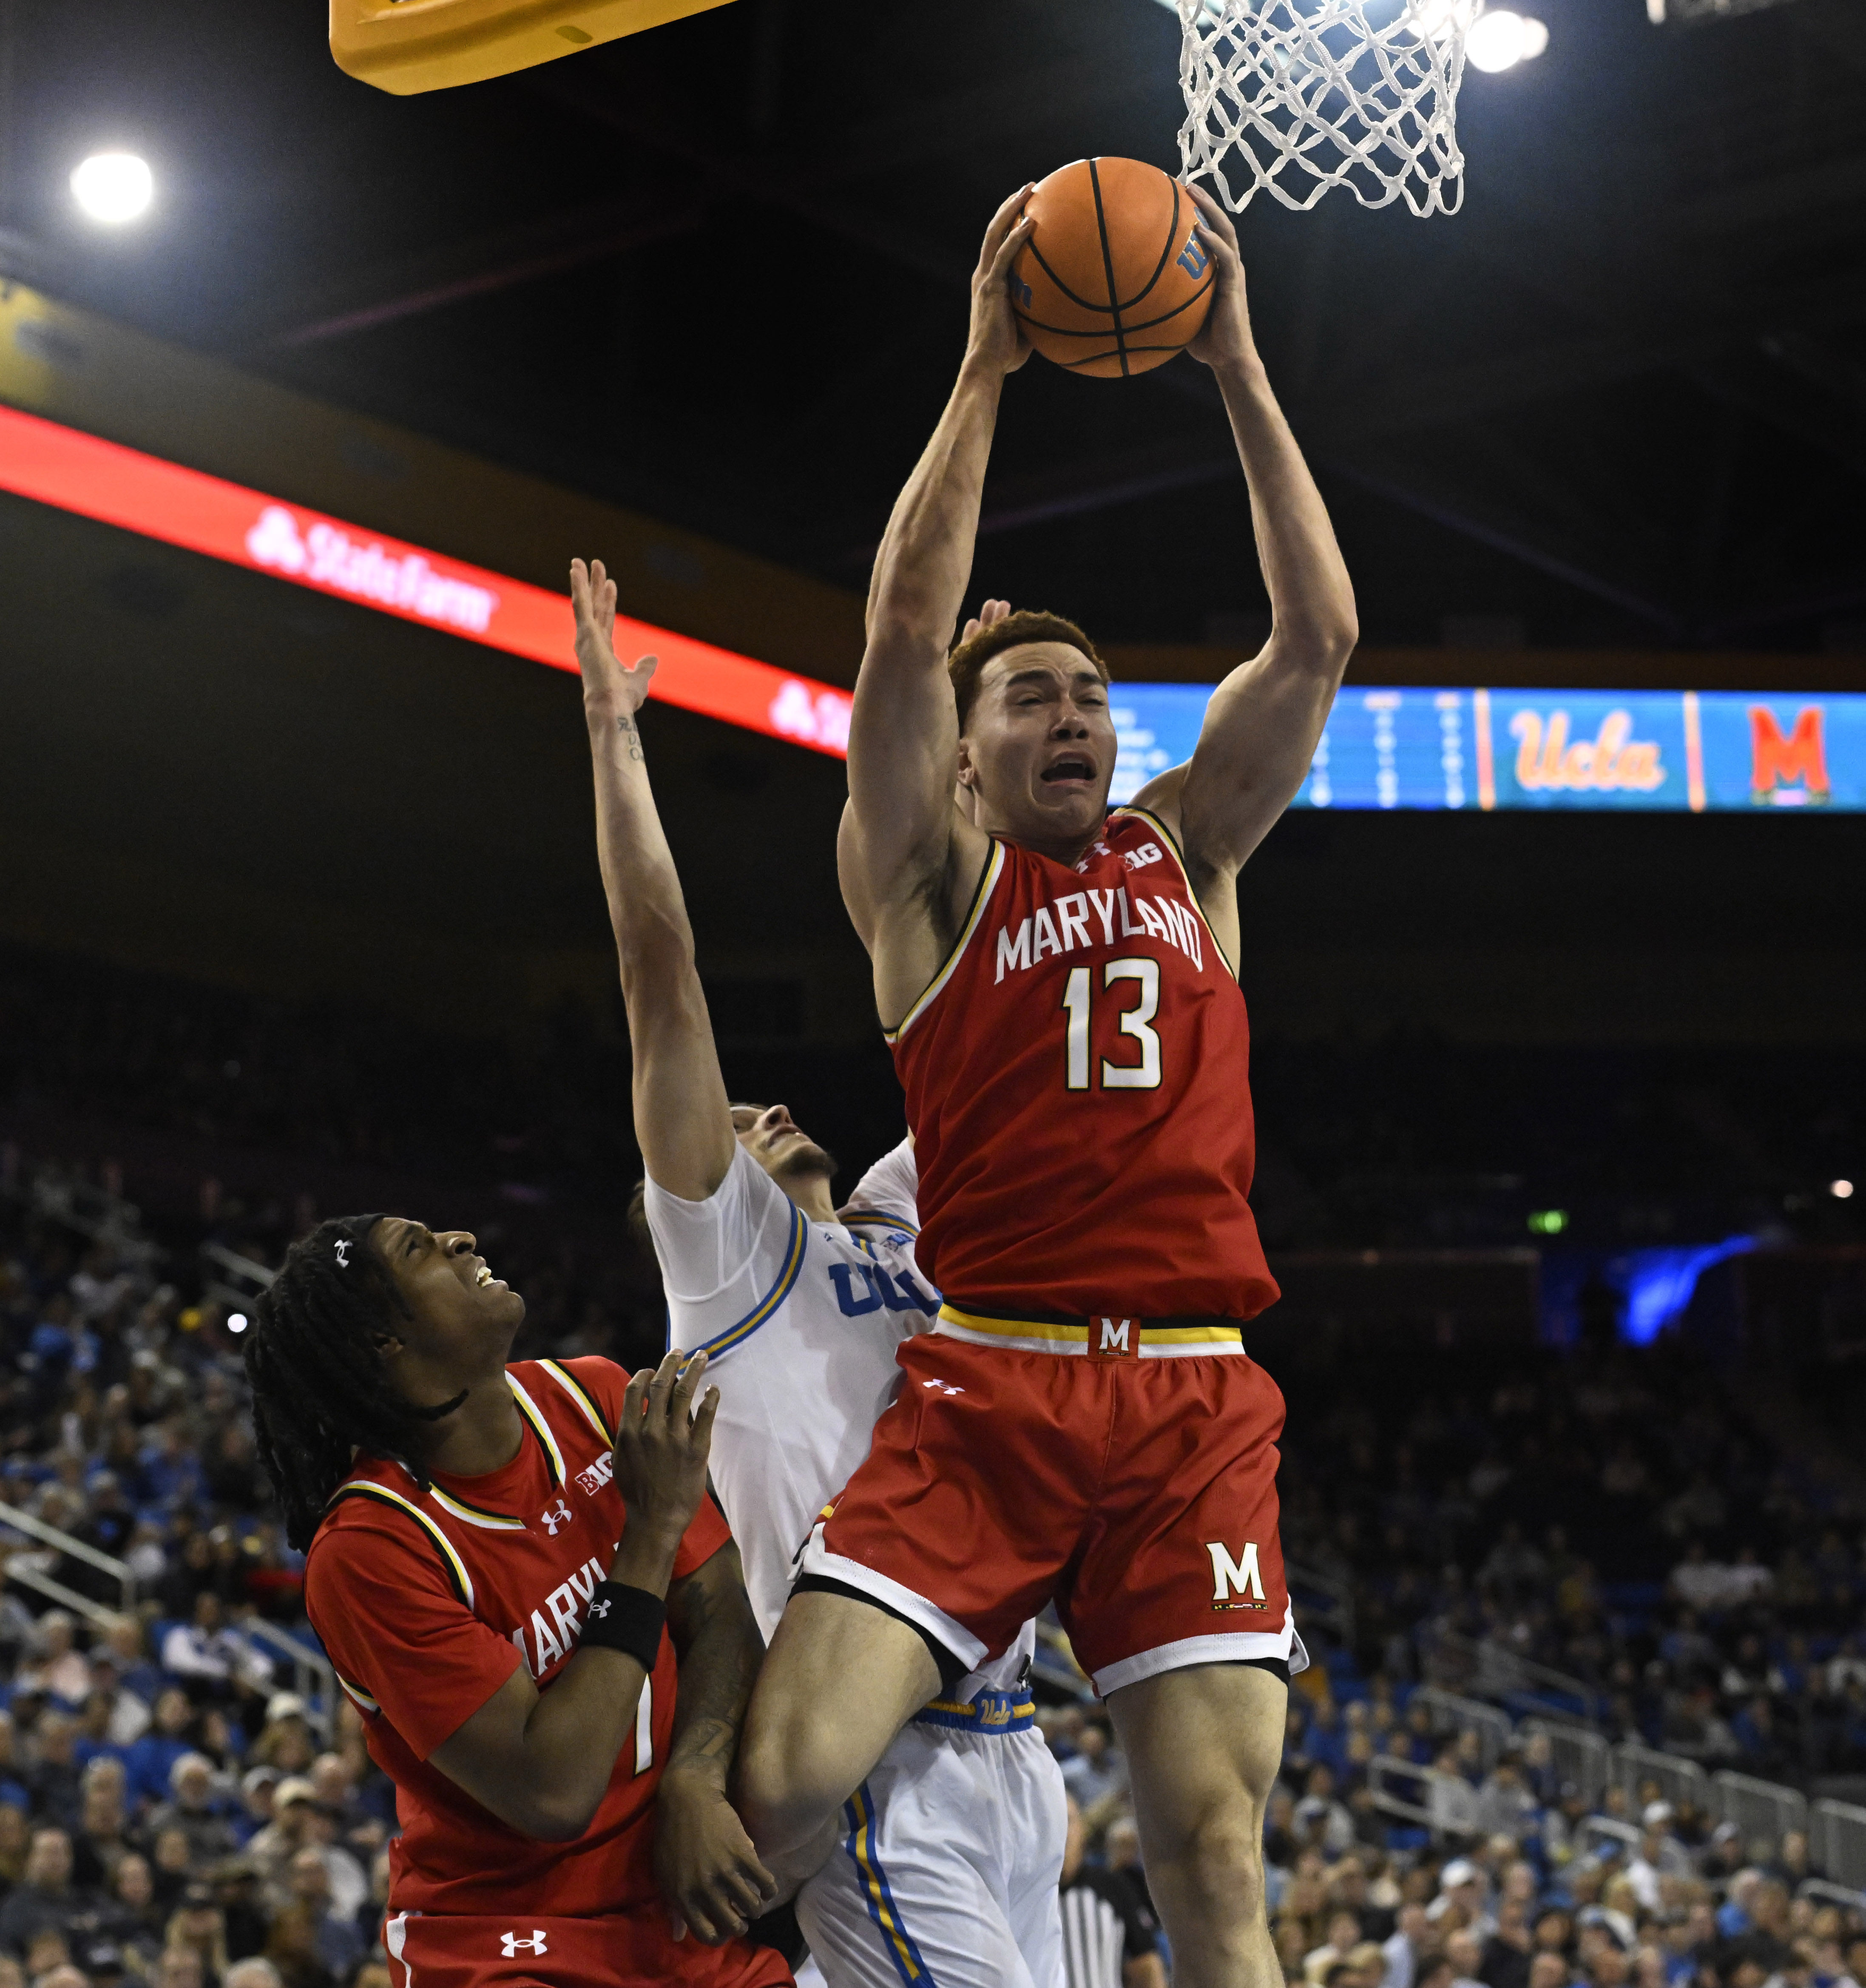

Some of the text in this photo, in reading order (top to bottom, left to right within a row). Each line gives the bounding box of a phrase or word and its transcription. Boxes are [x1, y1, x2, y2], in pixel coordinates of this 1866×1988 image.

[1748, 705, 1830, 791] M
[994, 887, 1203, 985] MARYLAND
[1063, 957, 1162, 1091] 13
[1099, 1318, 1131, 1352] M
[1206, 1542, 1266, 1600] M
